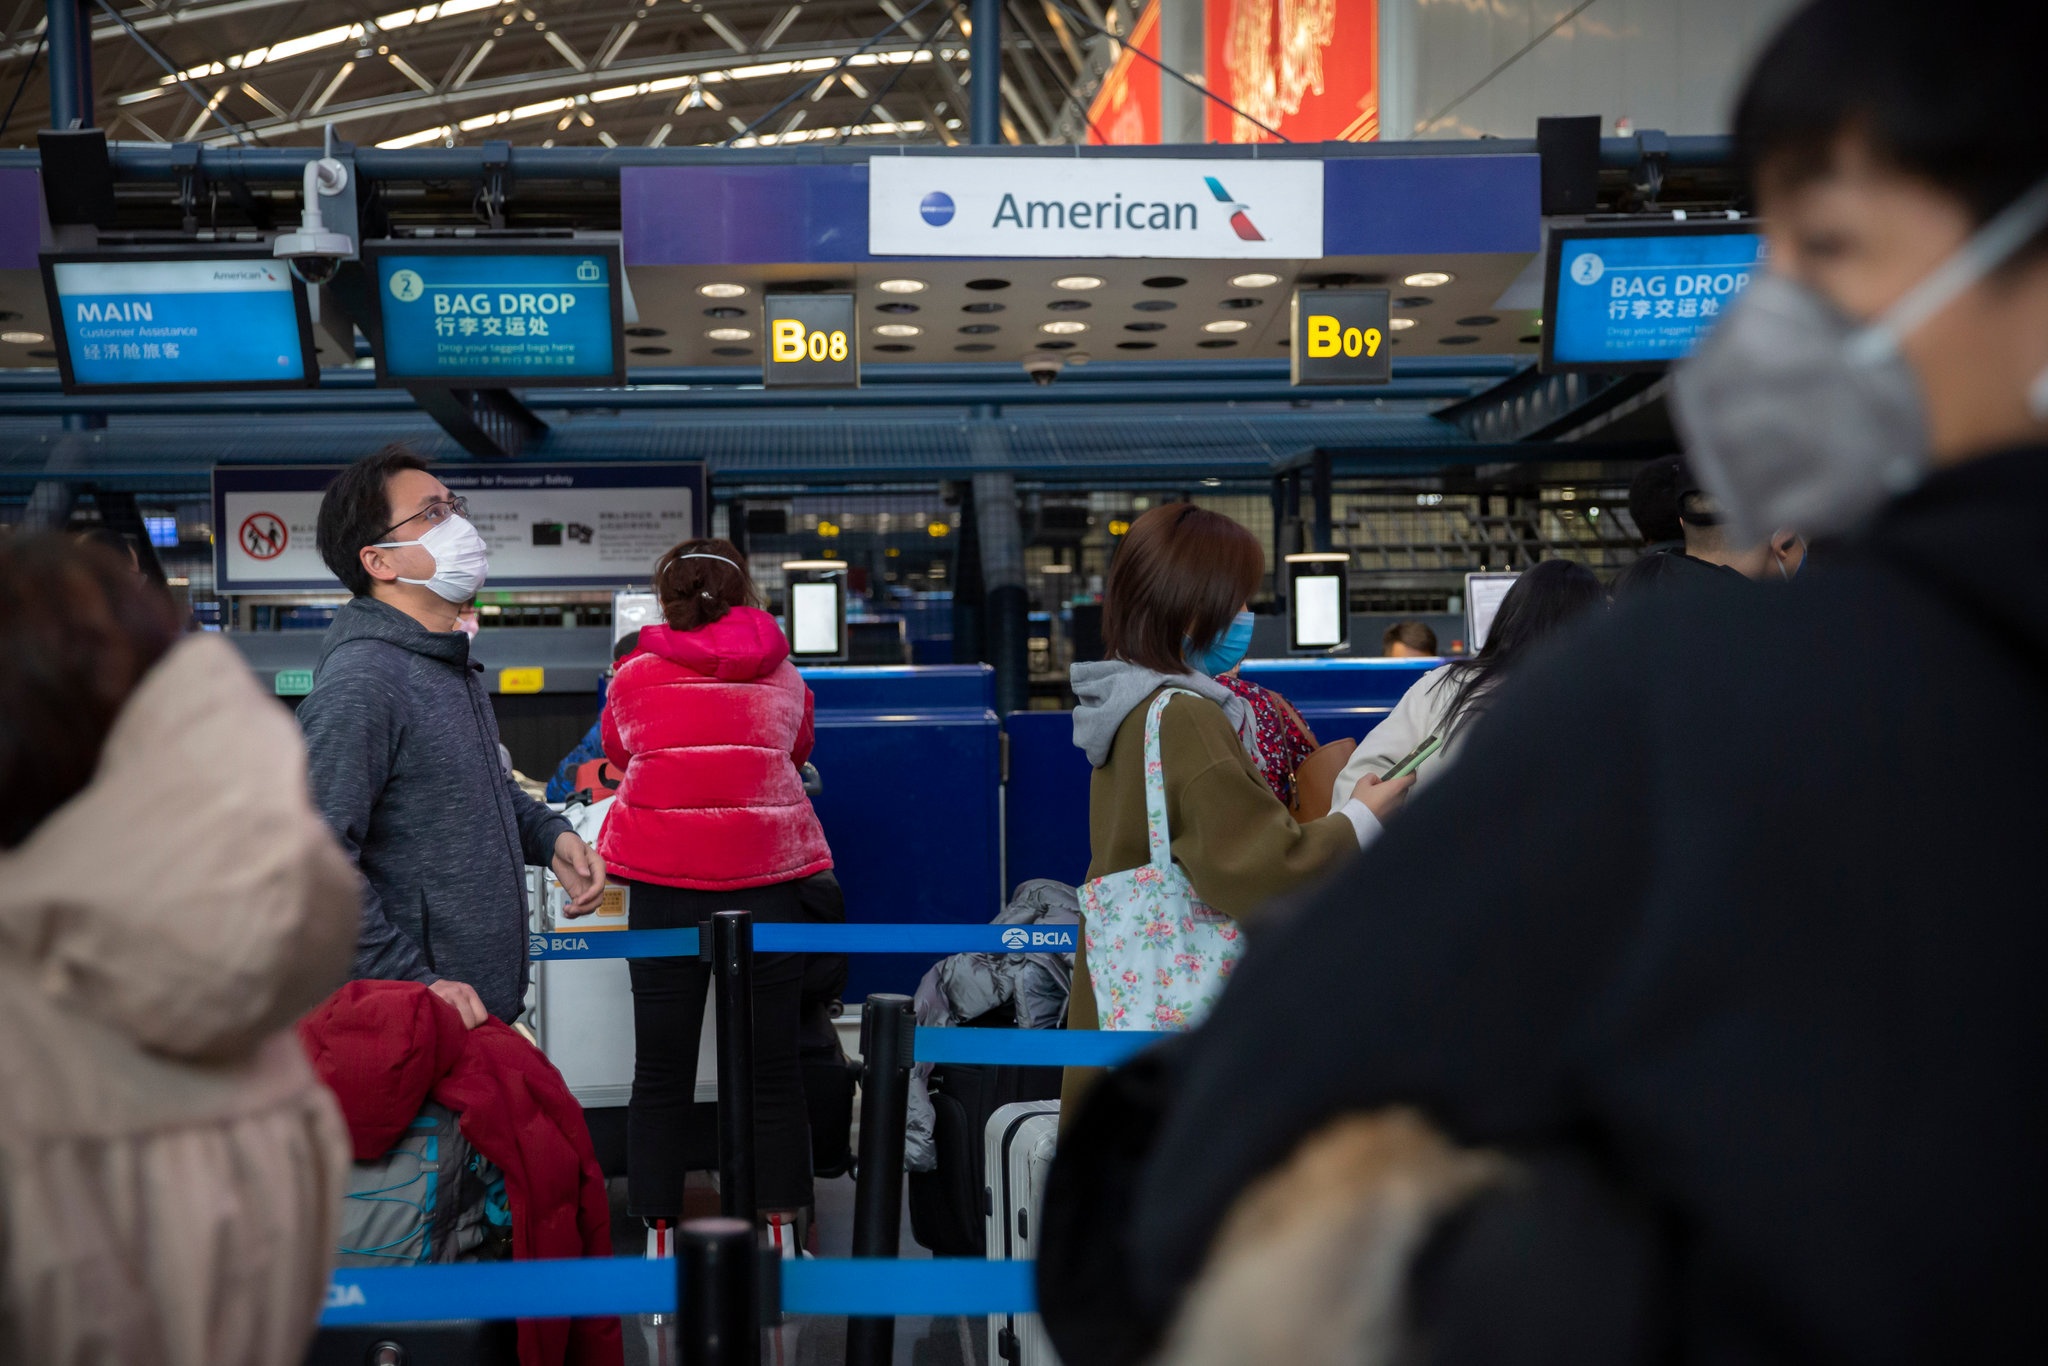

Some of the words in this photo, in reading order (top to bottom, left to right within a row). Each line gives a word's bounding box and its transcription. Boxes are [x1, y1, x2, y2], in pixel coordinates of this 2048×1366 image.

[992, 193, 1198, 230] American
[213, 271, 261, 281] American
[1583, 262, 1593, 275] 2
[402, 278, 411, 292] 2
[1611, 276, 1667, 298] BAG
[1674, 273, 1750, 295] DROP
[77, 302, 153, 323] MAIN
[434, 293, 491, 315] BAG
[499, 293, 576, 314] DROP
[1608, 297, 1719, 320] 行李交运处
[80, 327, 134, 338] Customer
[139, 326, 198, 337] Assistance
[434, 316, 549, 336] 行李交运处
[772, 318, 848, 362] B08
[1307, 315, 1382, 358] B09
[83, 343, 180, 360] 经济舱旅客
[551, 938, 589, 951] BCIA
[1032, 932, 1072, 946] BCIA
